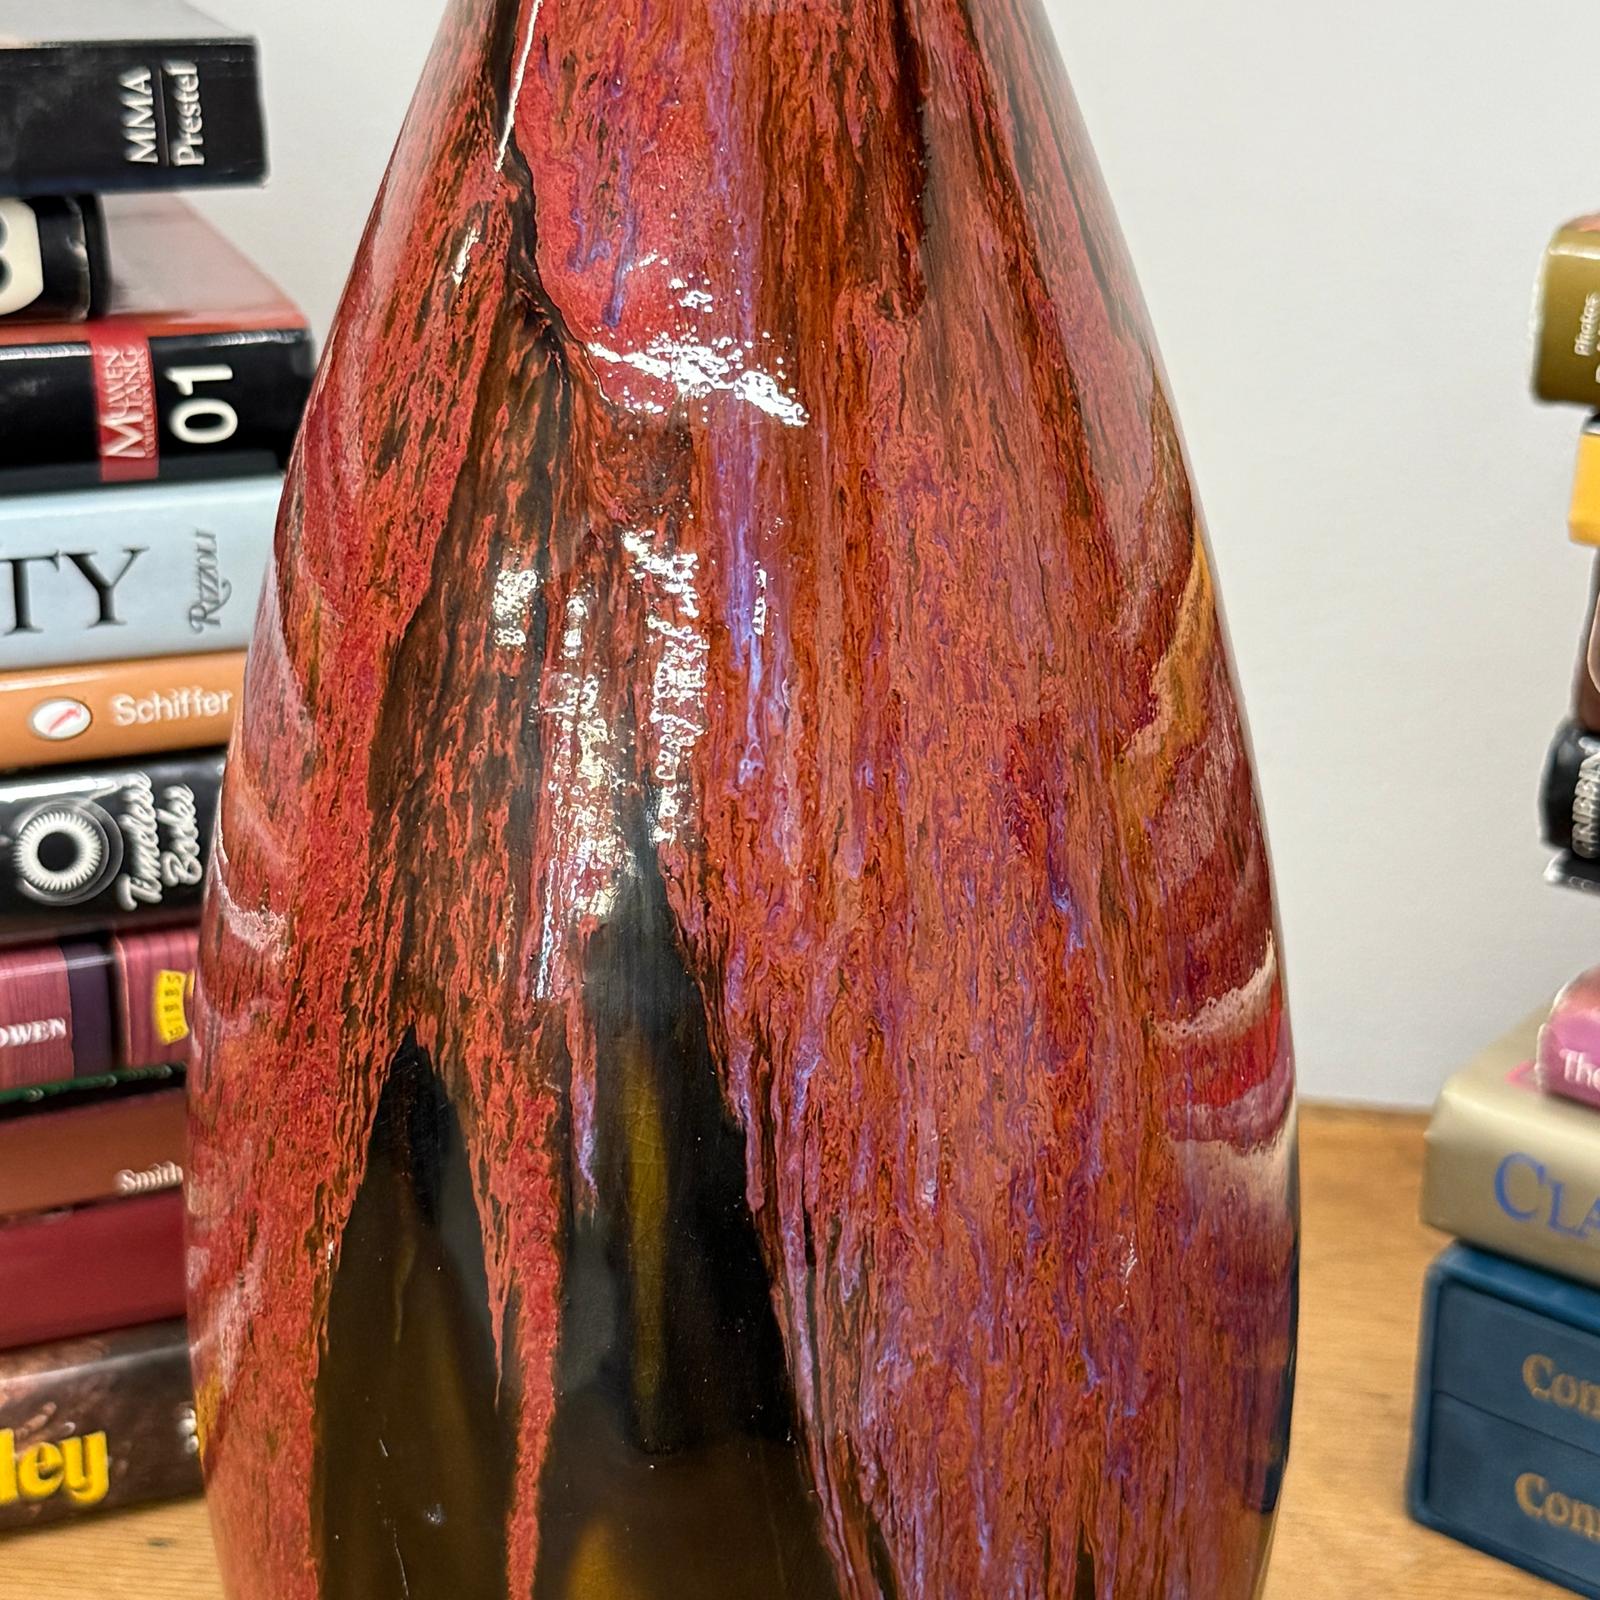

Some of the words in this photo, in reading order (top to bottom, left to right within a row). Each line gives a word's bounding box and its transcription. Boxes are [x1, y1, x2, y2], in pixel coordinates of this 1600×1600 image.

[119, 65, 158, 163] MMA
[162, 59, 205, 166] Prestel
[164, 364, 239, 444] 01
[0, 546, 150, 636] TY
[112, 686, 233, 728] Schiffer
[117, 770, 163, 911] Timeless
[156, 784, 203, 886] Books
